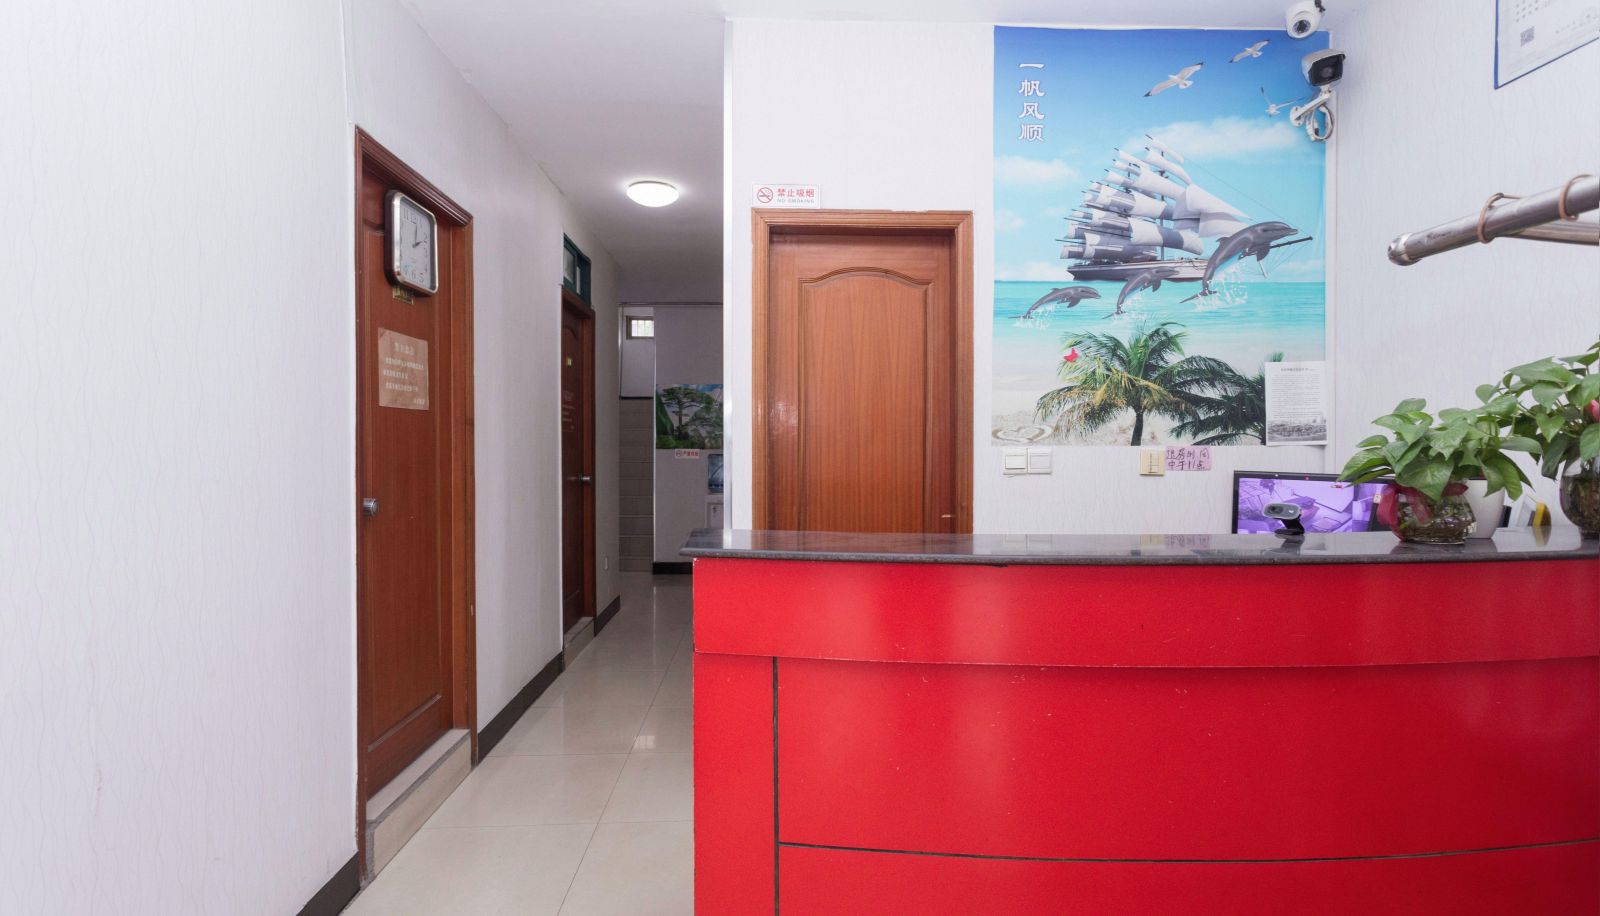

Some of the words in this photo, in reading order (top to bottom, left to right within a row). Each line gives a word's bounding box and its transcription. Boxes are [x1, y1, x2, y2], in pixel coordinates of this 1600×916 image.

[1018, 63, 1045, 141] 一帆风顺
[777, 188, 815, 198] 禁止吸烟
